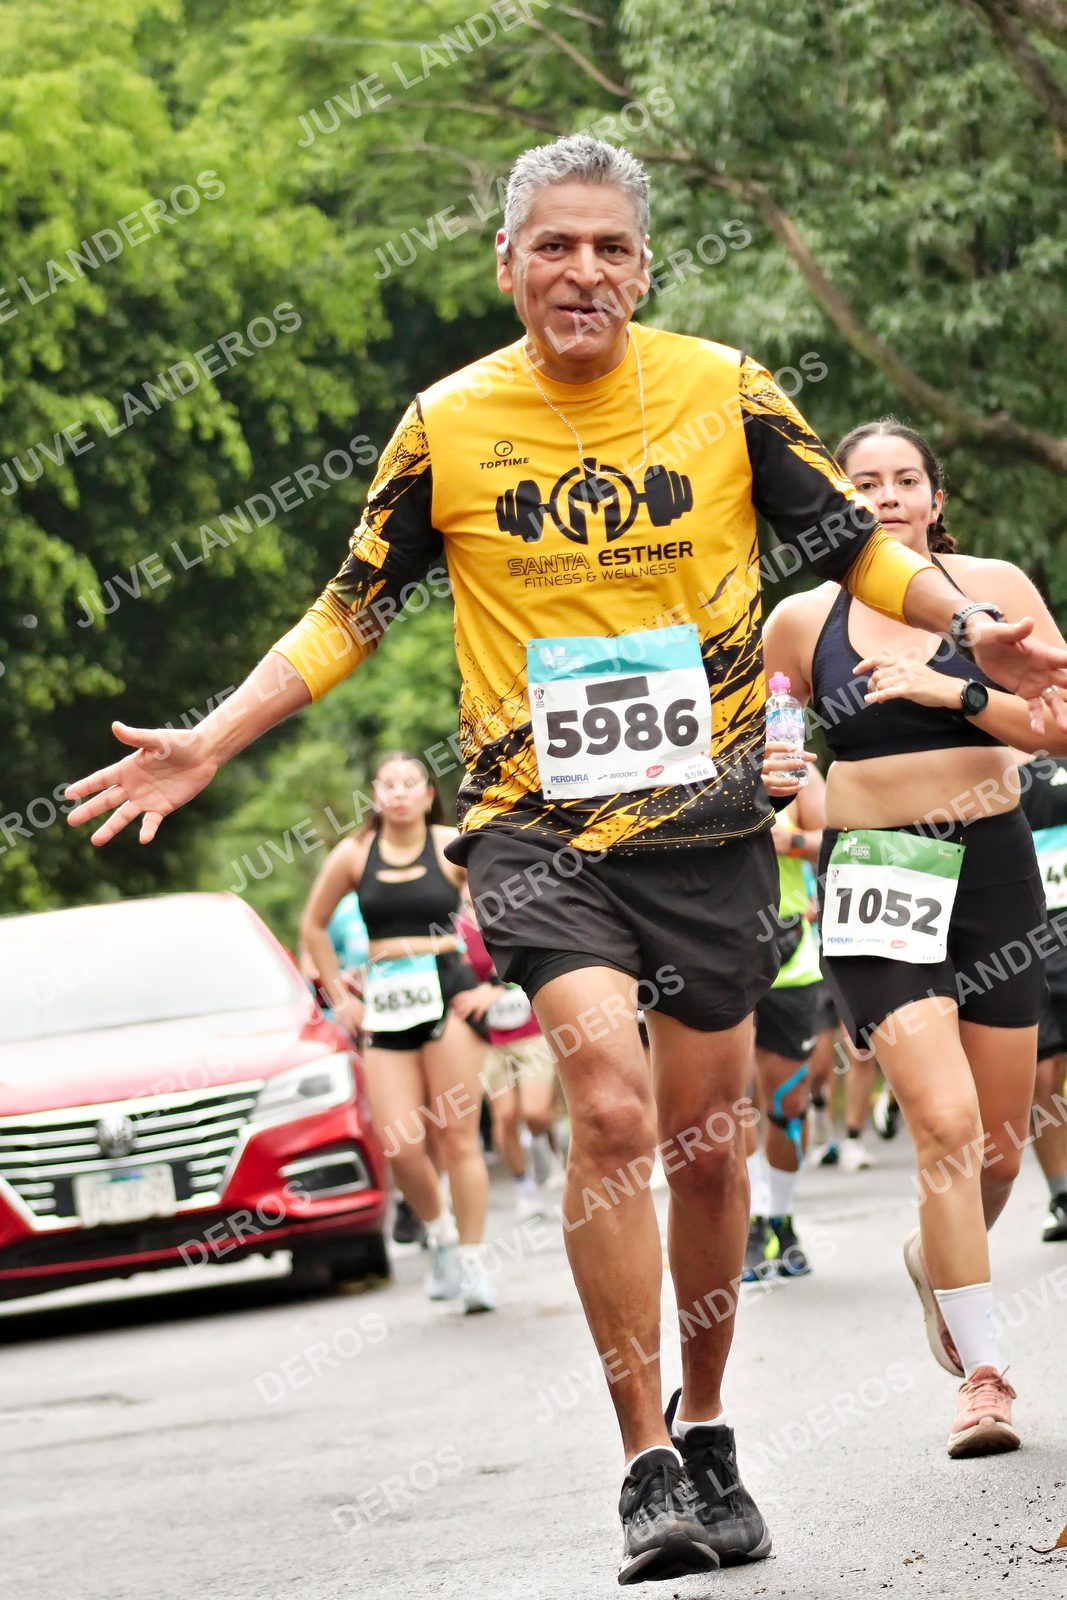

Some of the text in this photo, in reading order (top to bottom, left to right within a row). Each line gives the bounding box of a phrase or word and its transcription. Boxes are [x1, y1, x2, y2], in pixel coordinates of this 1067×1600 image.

[479, 457, 530, 470] TOPTIME
[507, 540, 693, 577] SANTA ESTHER
[524, 562, 677, 588] FITNESS & WELLNESS
[546, 698, 699, 759] 5986
[550, 774, 589, 783] PERDURA
[609, 771, 638, 780] BROOKS
[685, 768, 709, 780] 5986
[836, 887, 942, 937] 1052
